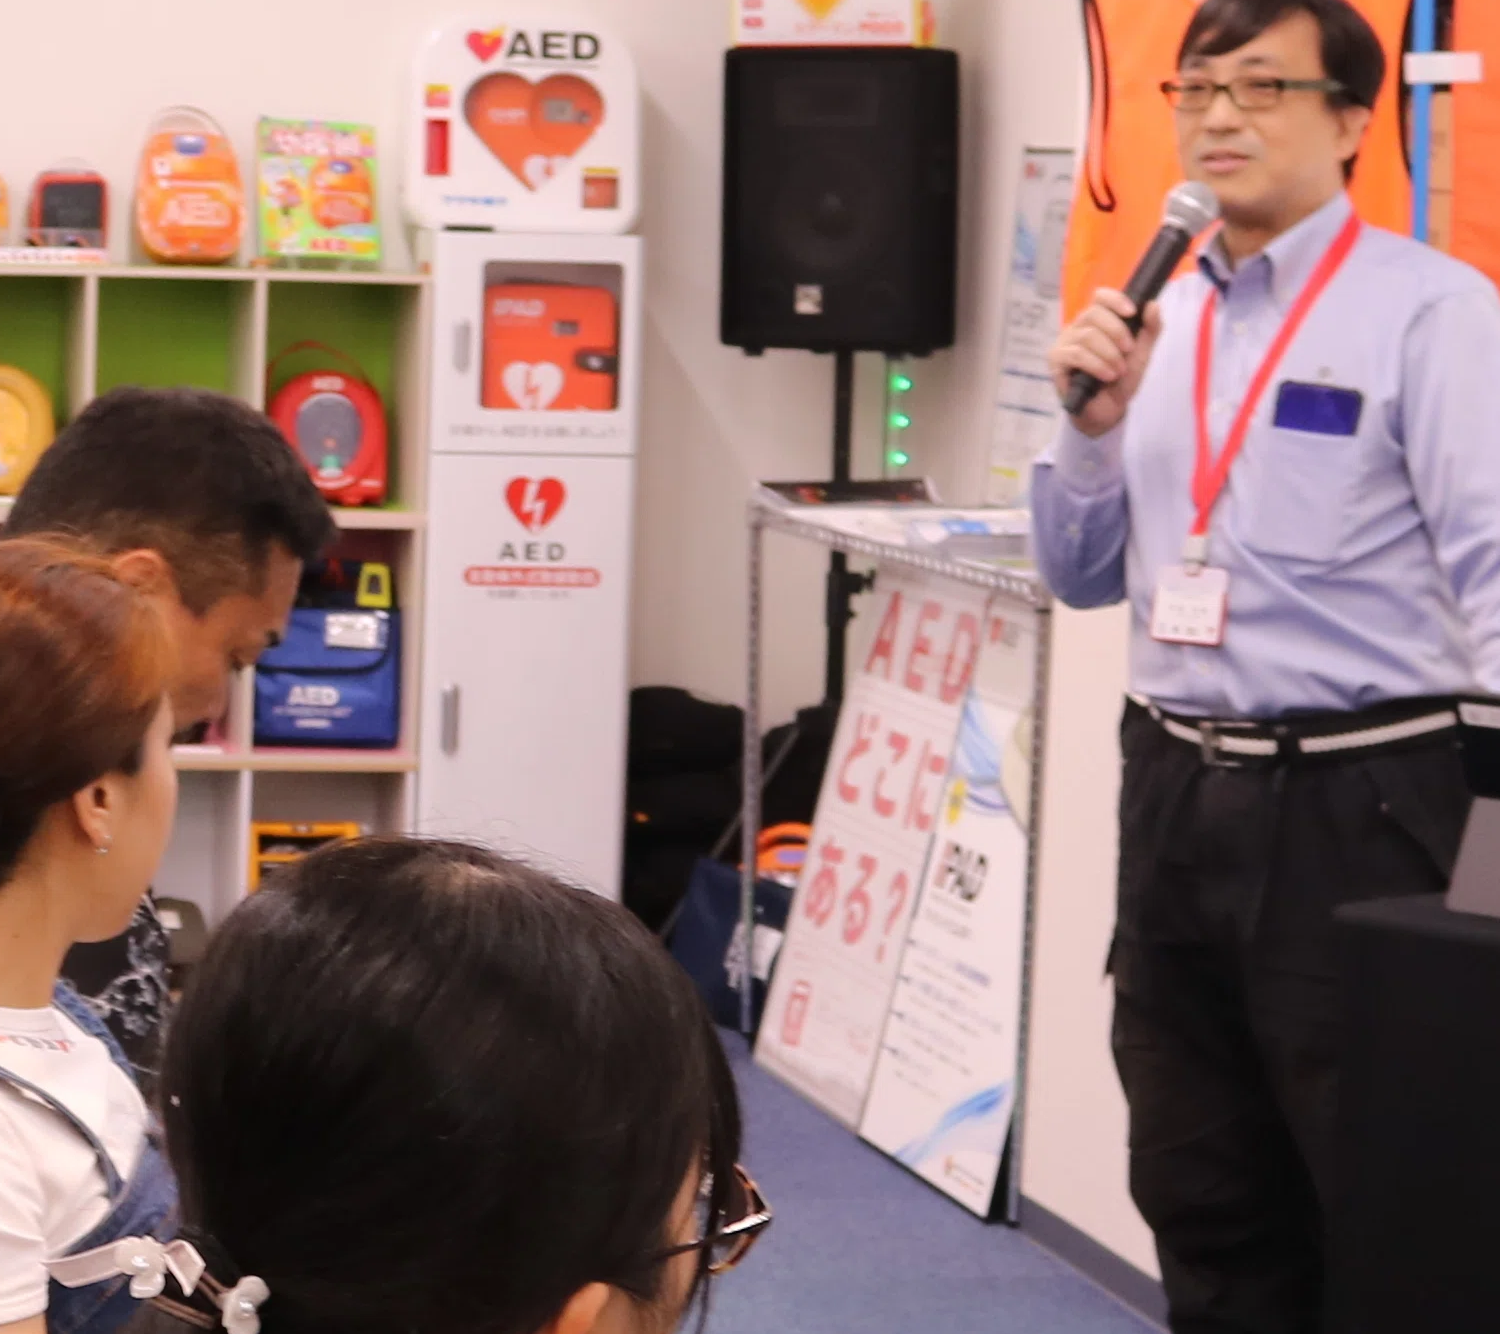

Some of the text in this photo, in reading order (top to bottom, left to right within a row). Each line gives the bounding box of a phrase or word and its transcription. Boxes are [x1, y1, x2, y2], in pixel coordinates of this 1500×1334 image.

[507, 30, 601, 61] AED
[499, 542, 567, 562] AED
[864, 589, 981, 706] AED
[286, 684, 341, 708] AED
[837, 712, 947, 832] どこに
